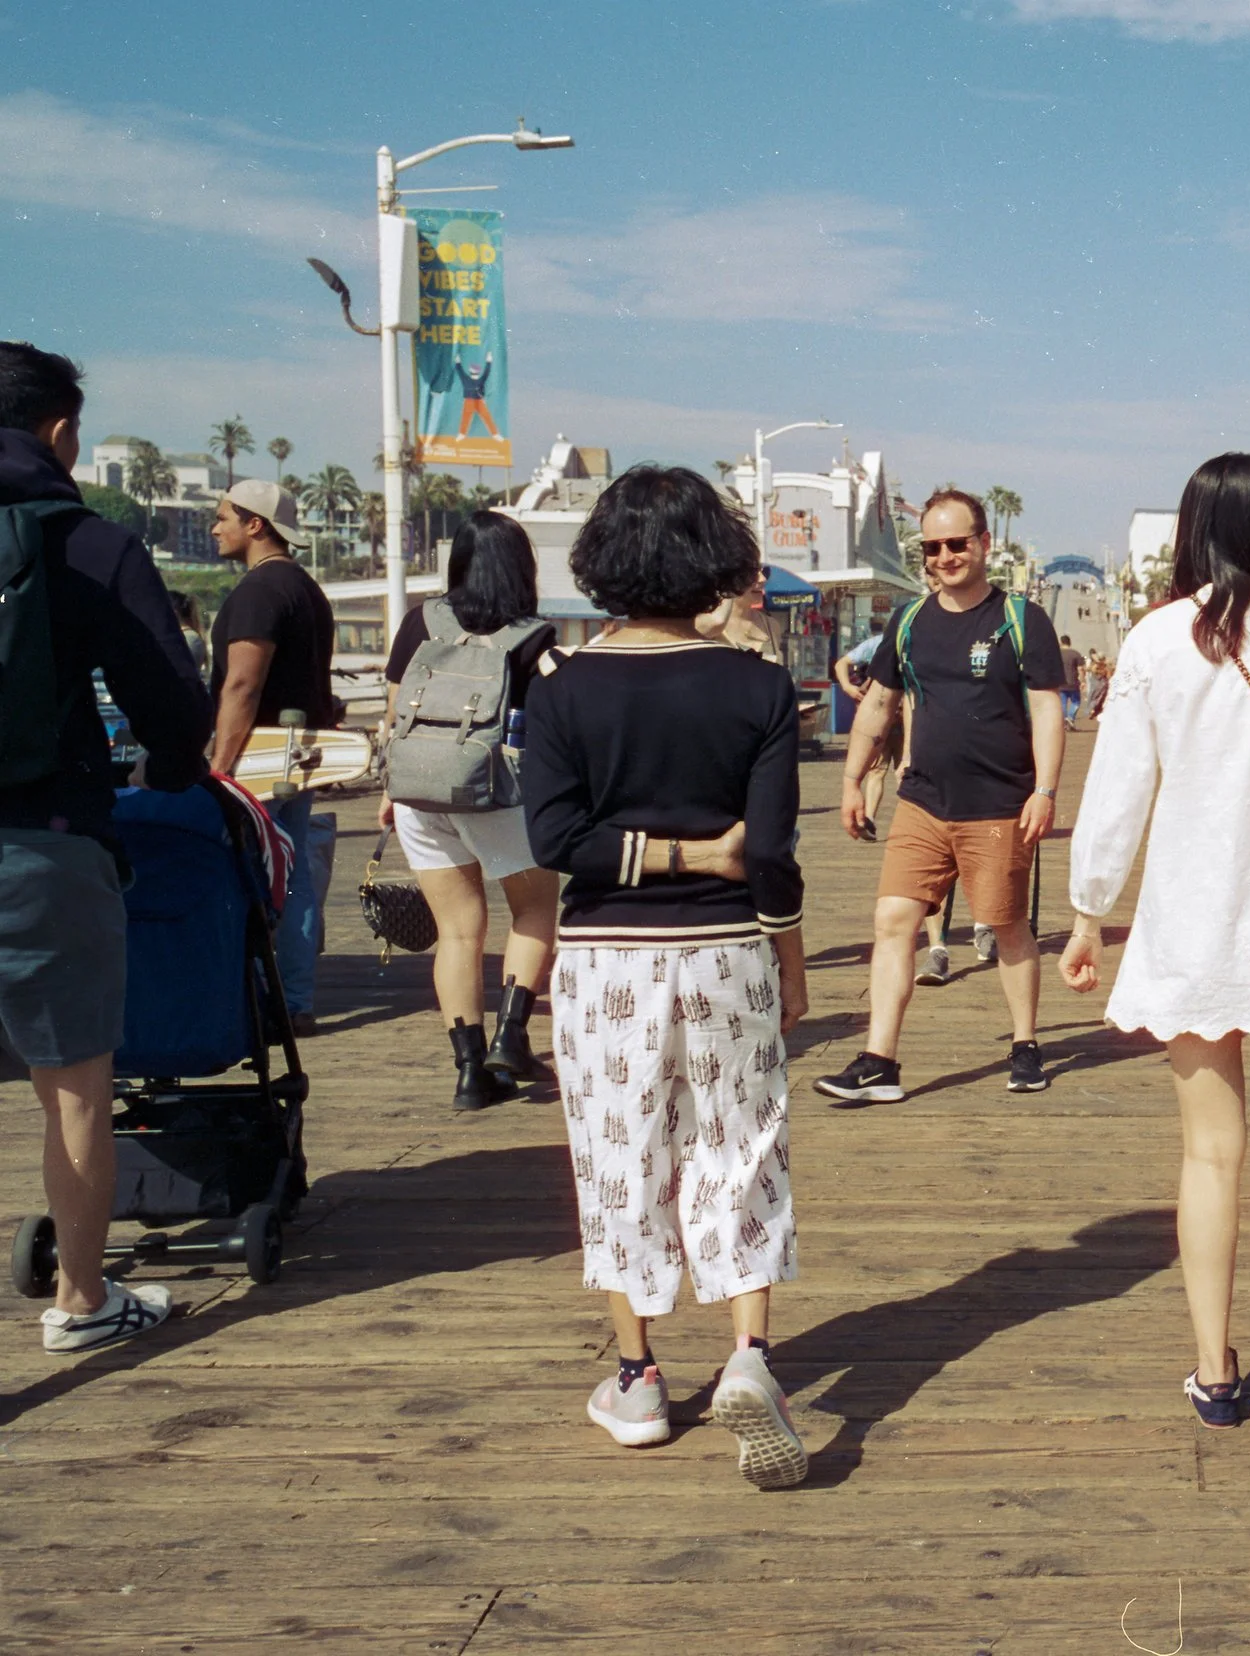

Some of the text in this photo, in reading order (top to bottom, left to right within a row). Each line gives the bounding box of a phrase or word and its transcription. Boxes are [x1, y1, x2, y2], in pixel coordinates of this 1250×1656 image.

[417, 241, 496, 264] GOOD
[419, 269, 485, 291] VIBES
[420, 297, 490, 319] START
[421, 324, 481, 345] HERE
